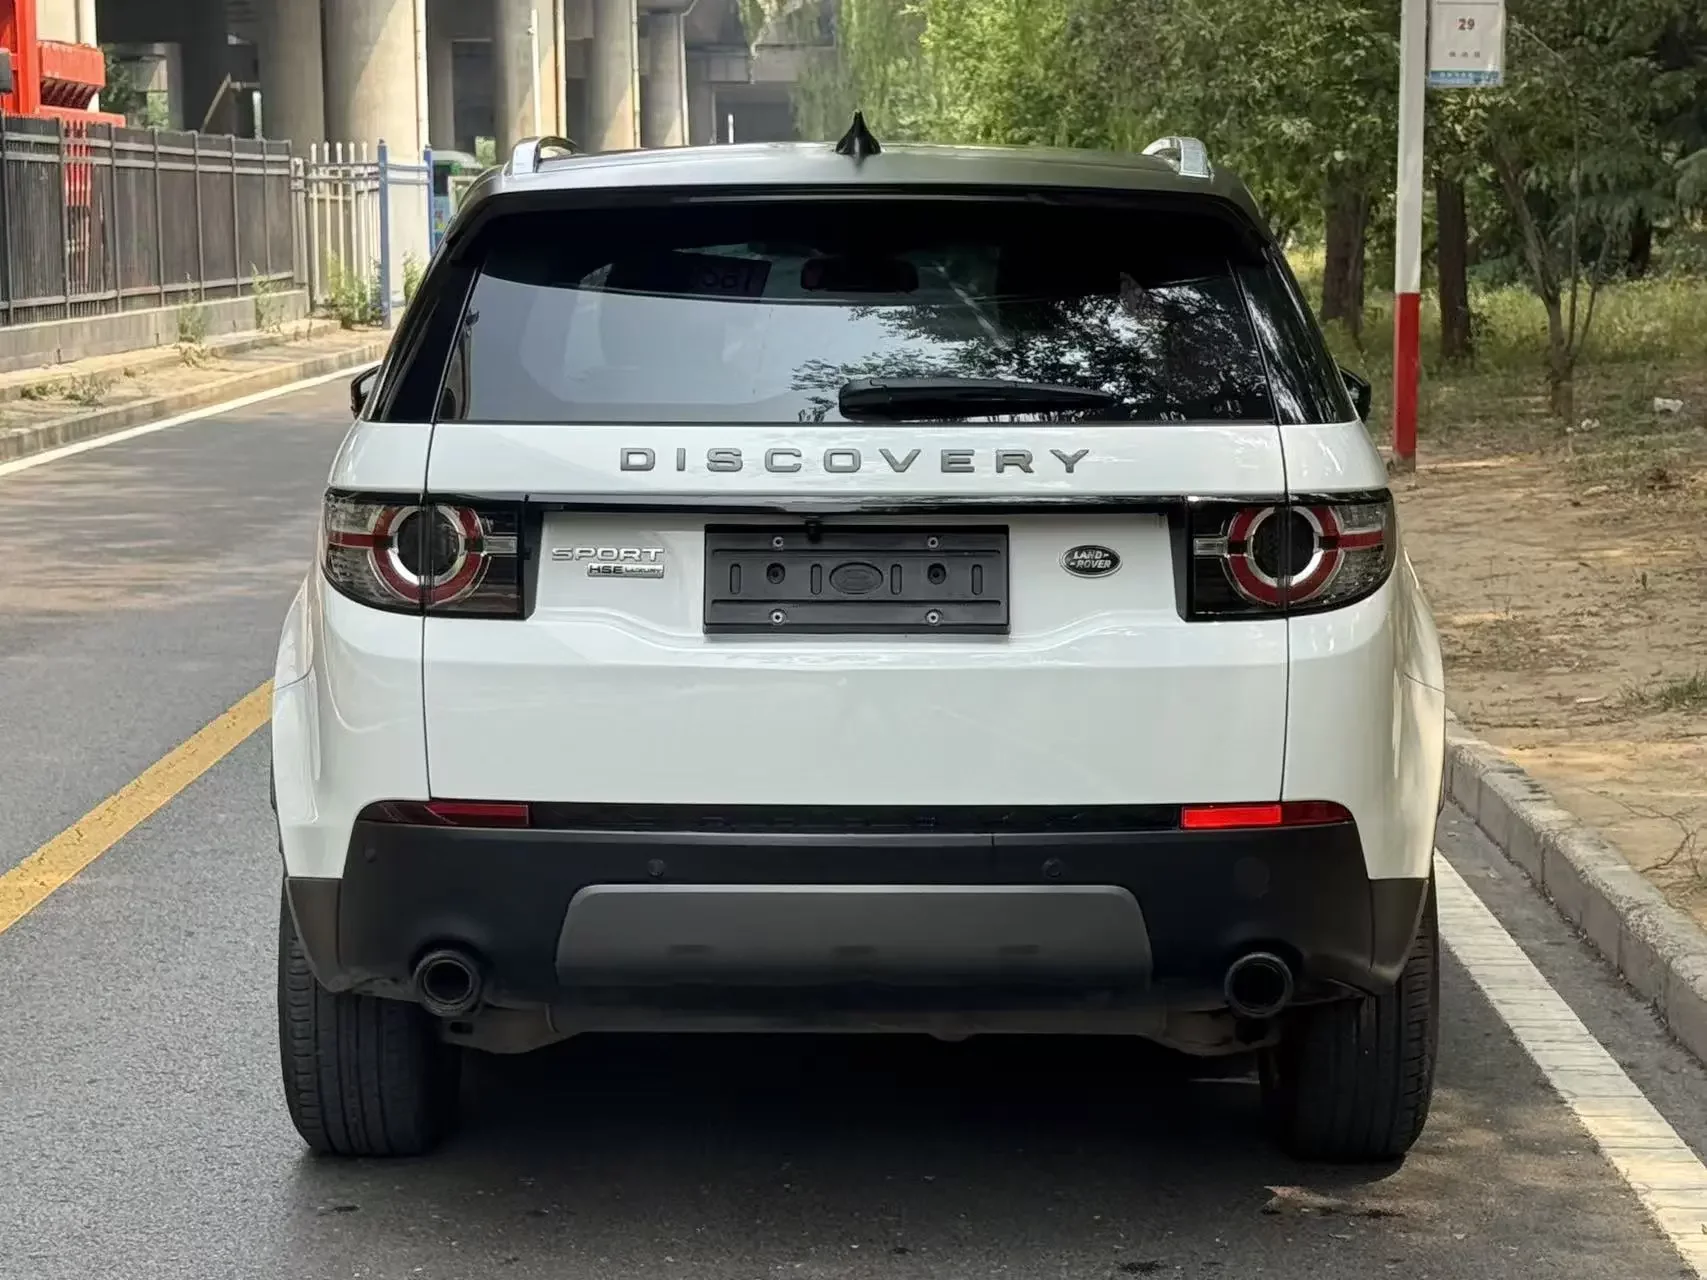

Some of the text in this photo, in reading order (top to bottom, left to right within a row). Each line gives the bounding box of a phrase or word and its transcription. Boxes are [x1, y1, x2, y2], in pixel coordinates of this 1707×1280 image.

[1458, 18, 1475, 30] 29
[620, 447, 1090, 474] DISCOVERY
[552, 547, 665, 562] SPORT
[589, 565, 624, 575] HSE
